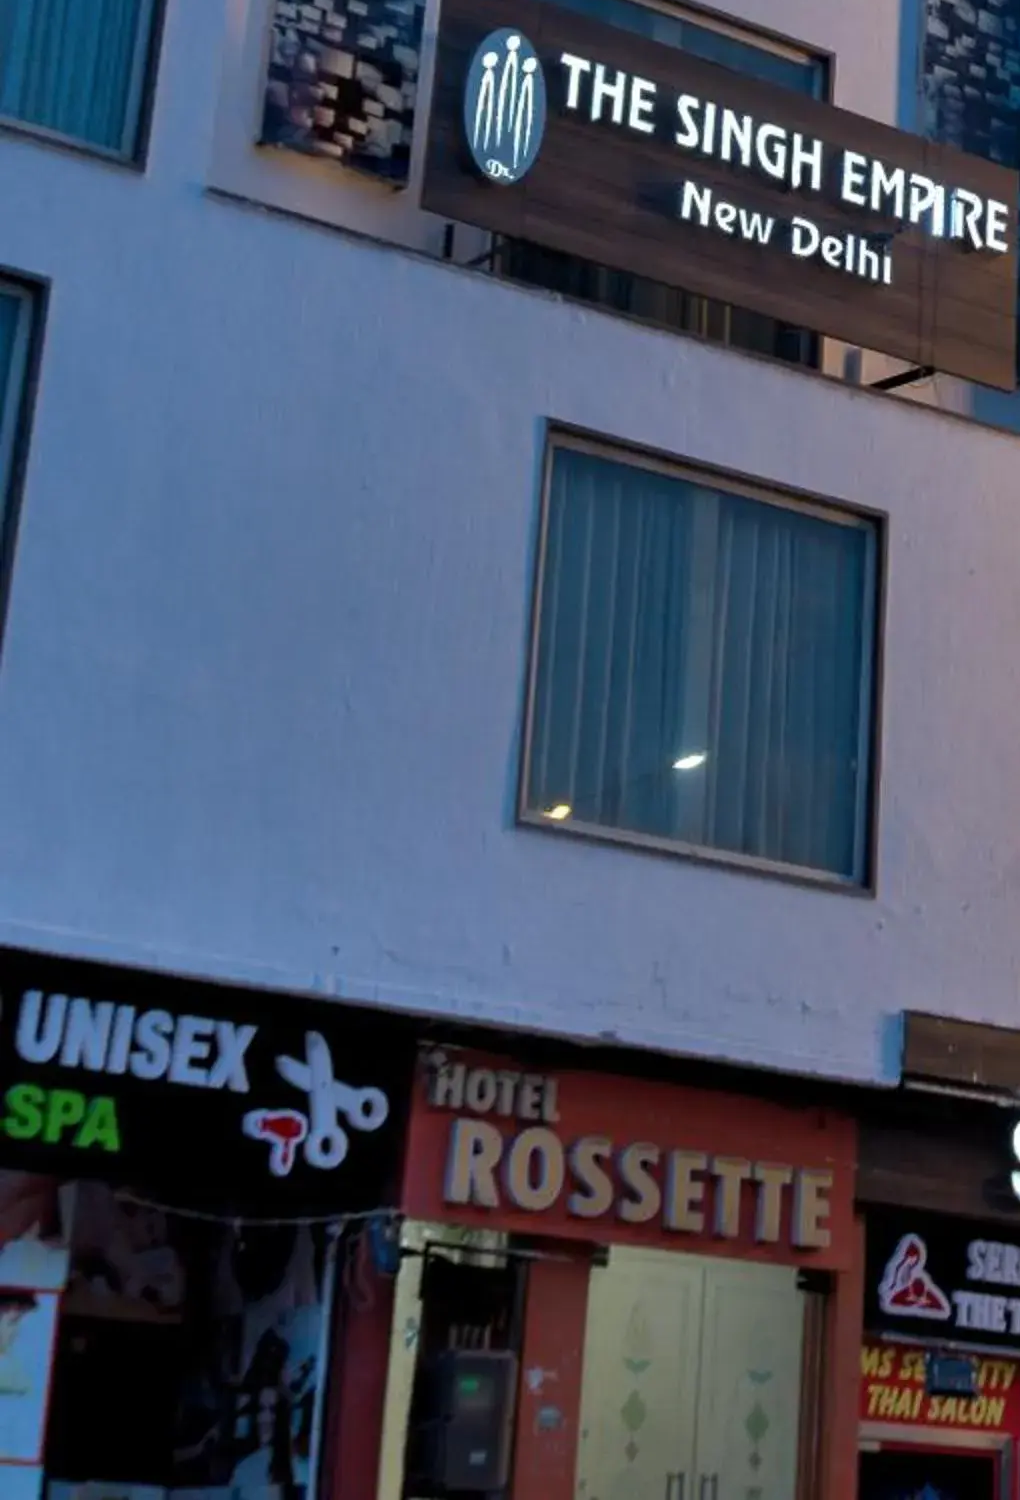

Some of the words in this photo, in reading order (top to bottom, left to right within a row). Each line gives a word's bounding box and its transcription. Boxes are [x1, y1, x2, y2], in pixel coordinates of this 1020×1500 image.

[560, 52, 657, 132] THE
[674, 93, 824, 192] SINGH
[841, 149, 1011, 254] EMPIRE
[680, 180, 774, 245] New
[790, 215, 894, 286] Delhi
[15, 990, 257, 1093] UNISEX
[1, 1083, 121, 1151] SPA
[428, 1062, 560, 1122] HOTEL
[445, 1117, 833, 1250] ROSSETTE
[952, 1290, 1008, 1332] THE
[867, 1383, 924, 1420] THAI
[927, 1394, 1006, 1428] SALON
